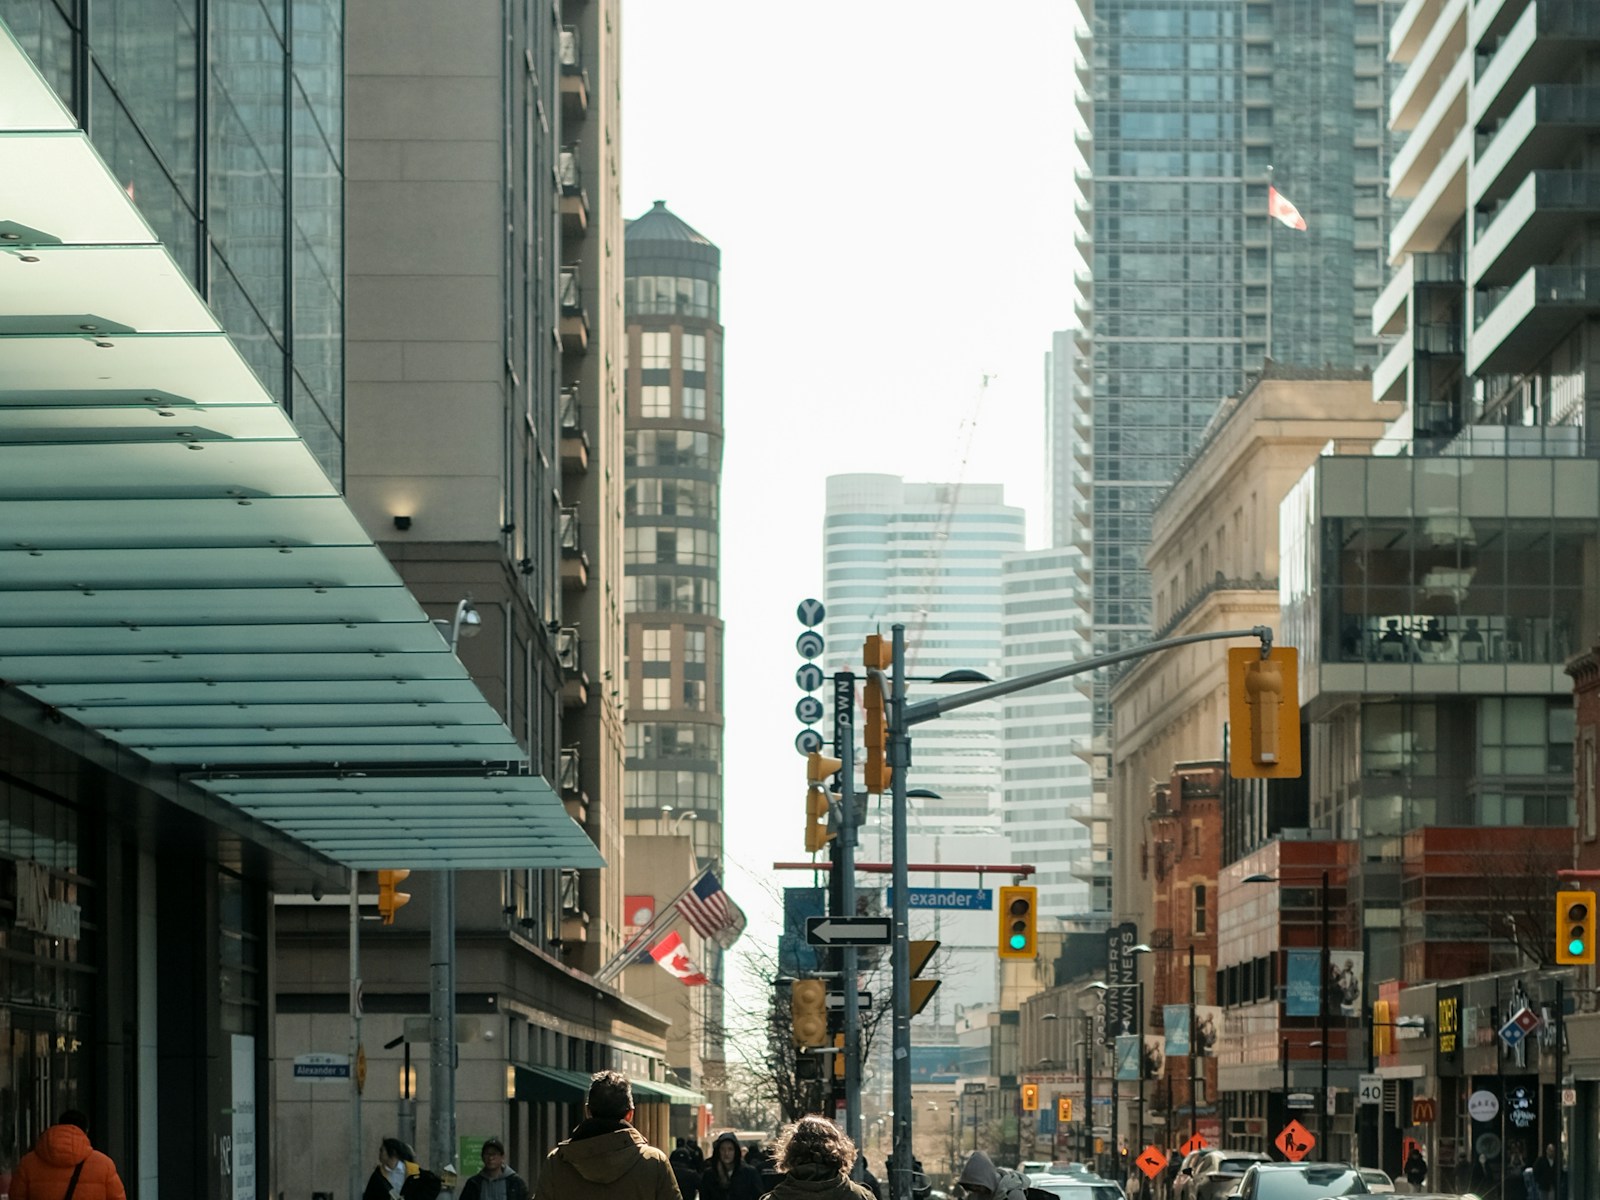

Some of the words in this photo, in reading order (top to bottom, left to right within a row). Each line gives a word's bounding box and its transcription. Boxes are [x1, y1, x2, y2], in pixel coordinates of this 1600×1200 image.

[796, 599, 825, 756] Yonge
[908, 891, 973, 906] exander
[1122, 932, 1134, 1021] WINNERS
[296, 1066, 336, 1075] Alexander
[1361, 1086, 1381, 1100] 40
